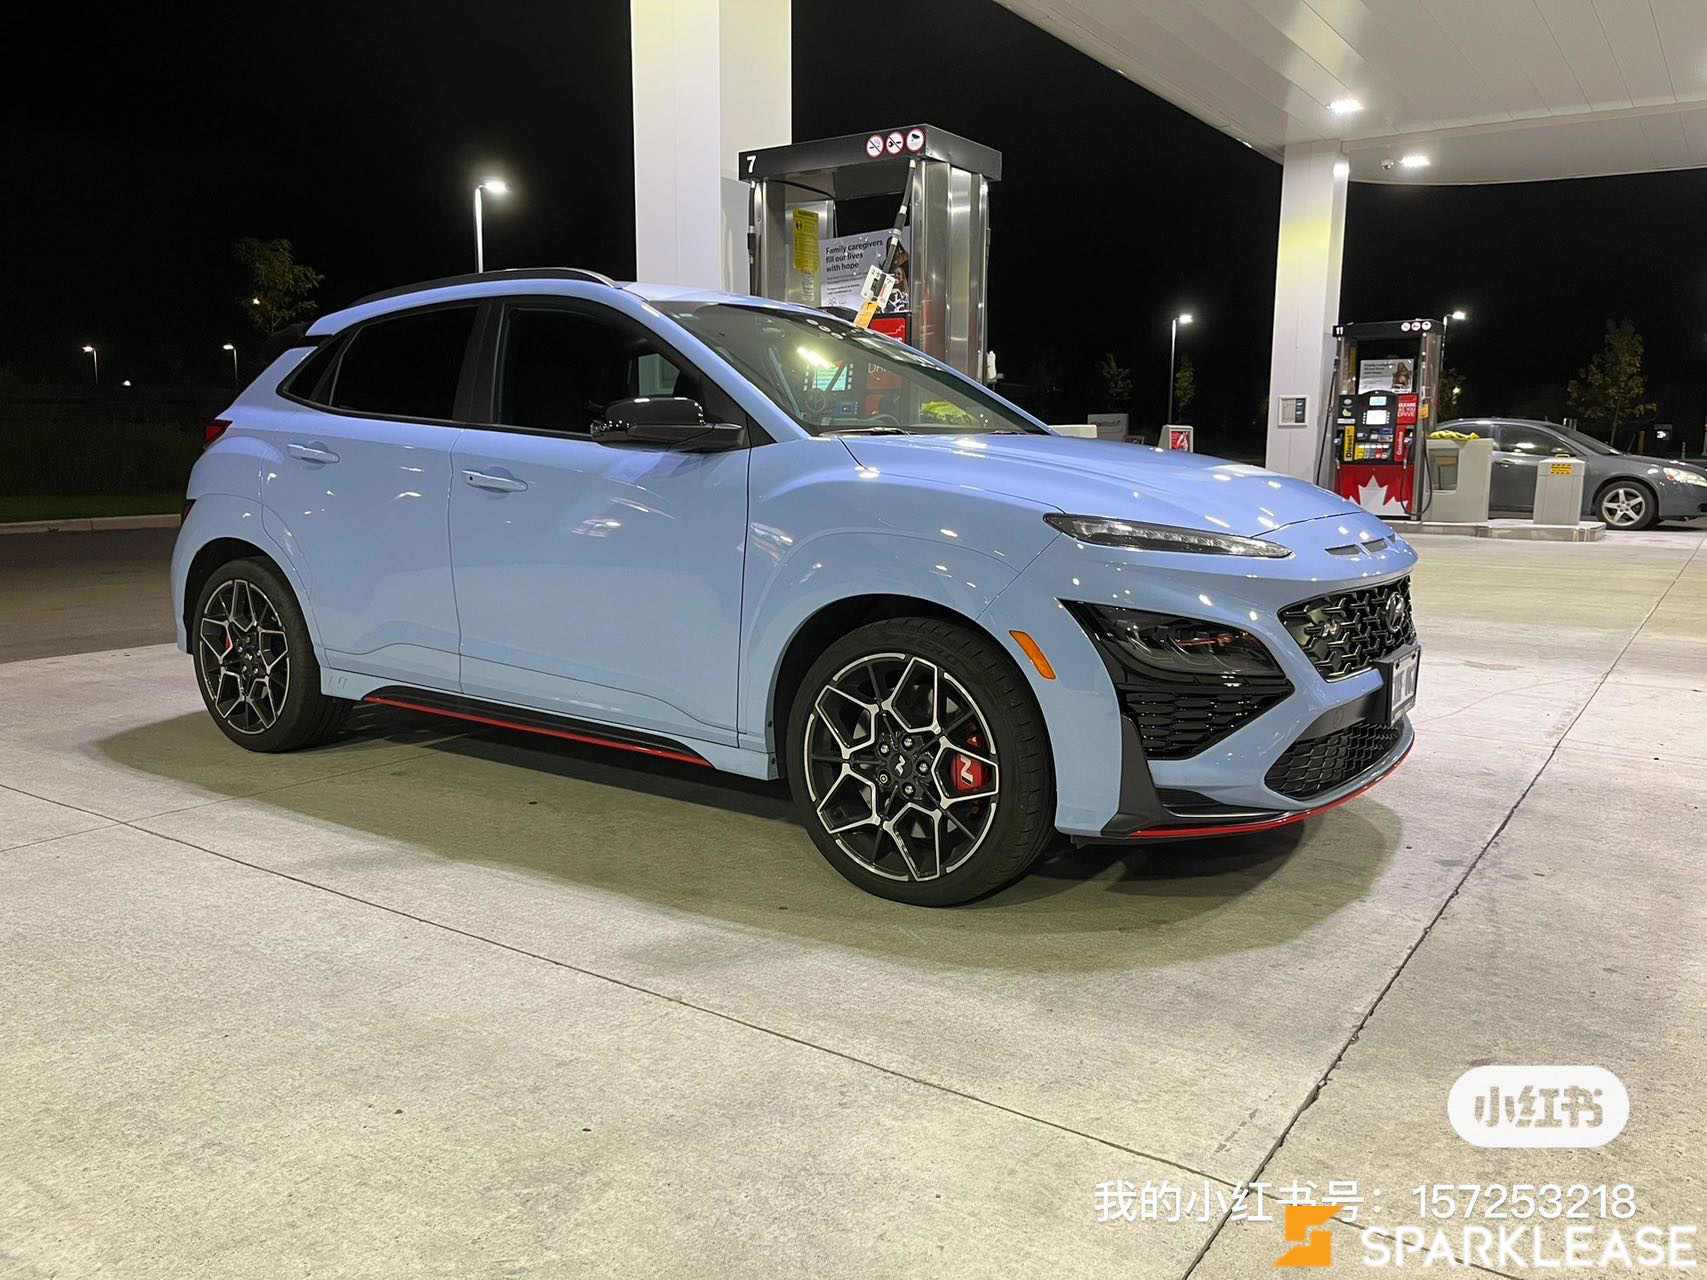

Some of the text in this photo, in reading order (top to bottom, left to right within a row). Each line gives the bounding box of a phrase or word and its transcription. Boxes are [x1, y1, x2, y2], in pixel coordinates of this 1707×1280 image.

[746, 155, 757, 173] 7
[826, 240, 883, 255] Family caregivers
[826, 255, 835, 264] fill
[847, 252, 863, 260] lives
[827, 262, 860, 272] with hope
[1336, 326, 1344, 335] 11
